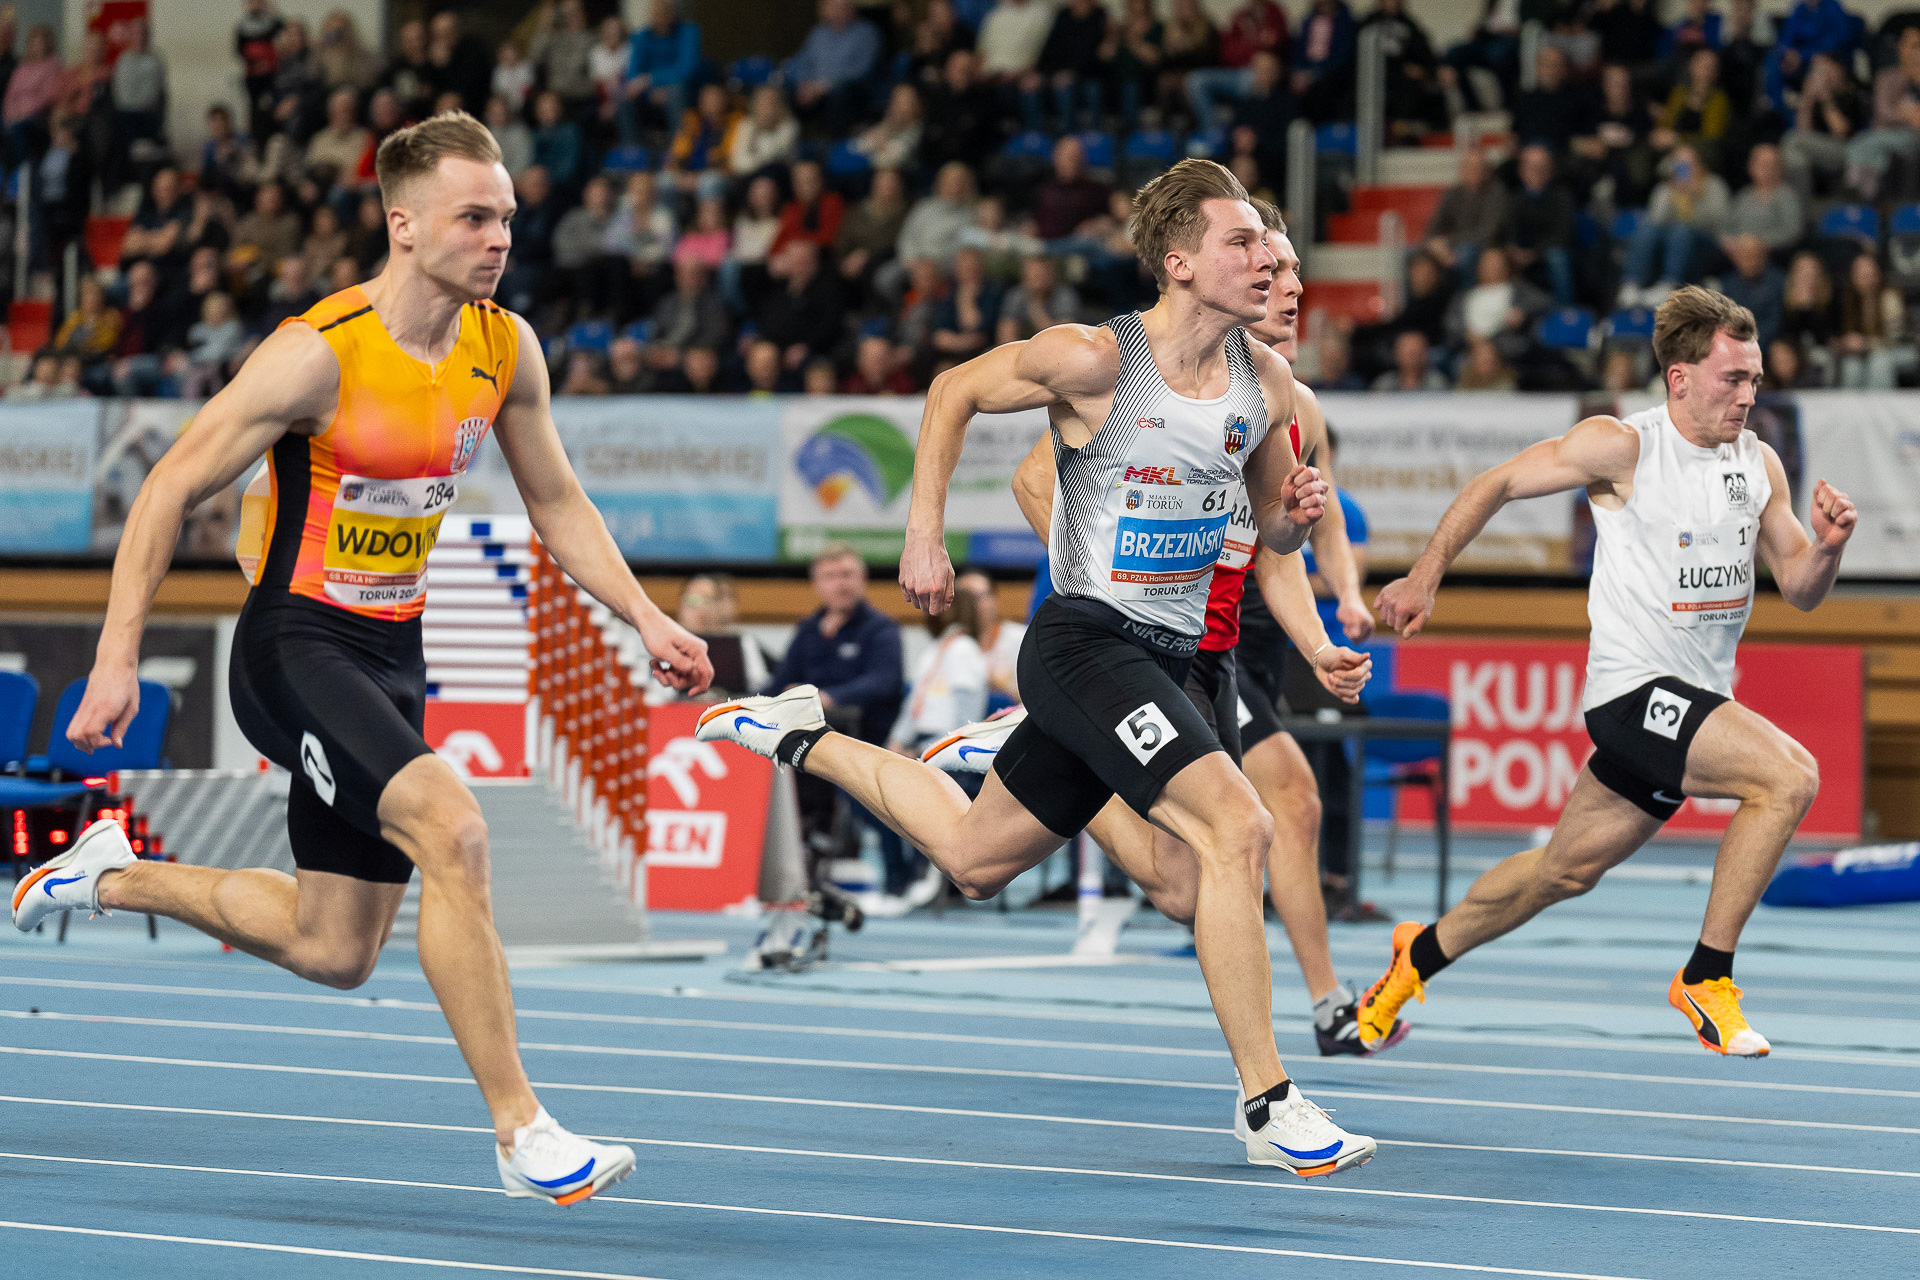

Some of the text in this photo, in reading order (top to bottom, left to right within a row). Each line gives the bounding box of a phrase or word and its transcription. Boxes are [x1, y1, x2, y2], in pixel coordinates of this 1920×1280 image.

[1123, 465, 1182, 486] MKL
[1146, 498, 1184, 510] TORUŃ
[1202, 489, 1227, 512] 61
[1119, 525, 1226, 559] BRZEZIŃSKI
[1117, 573, 1129, 581] 69.
[1130, 574, 1148, 582] PZLA
[359, 587, 396, 600] TORUŃ
[1143, 582, 1200, 597] TORUŃ 2025
[1698, 611, 1728, 622] TORUŃ
[1122, 620, 1198, 652] NIKE PRO
[1650, 701, 1681, 727] 3
[1127, 709, 1162, 751] 5
